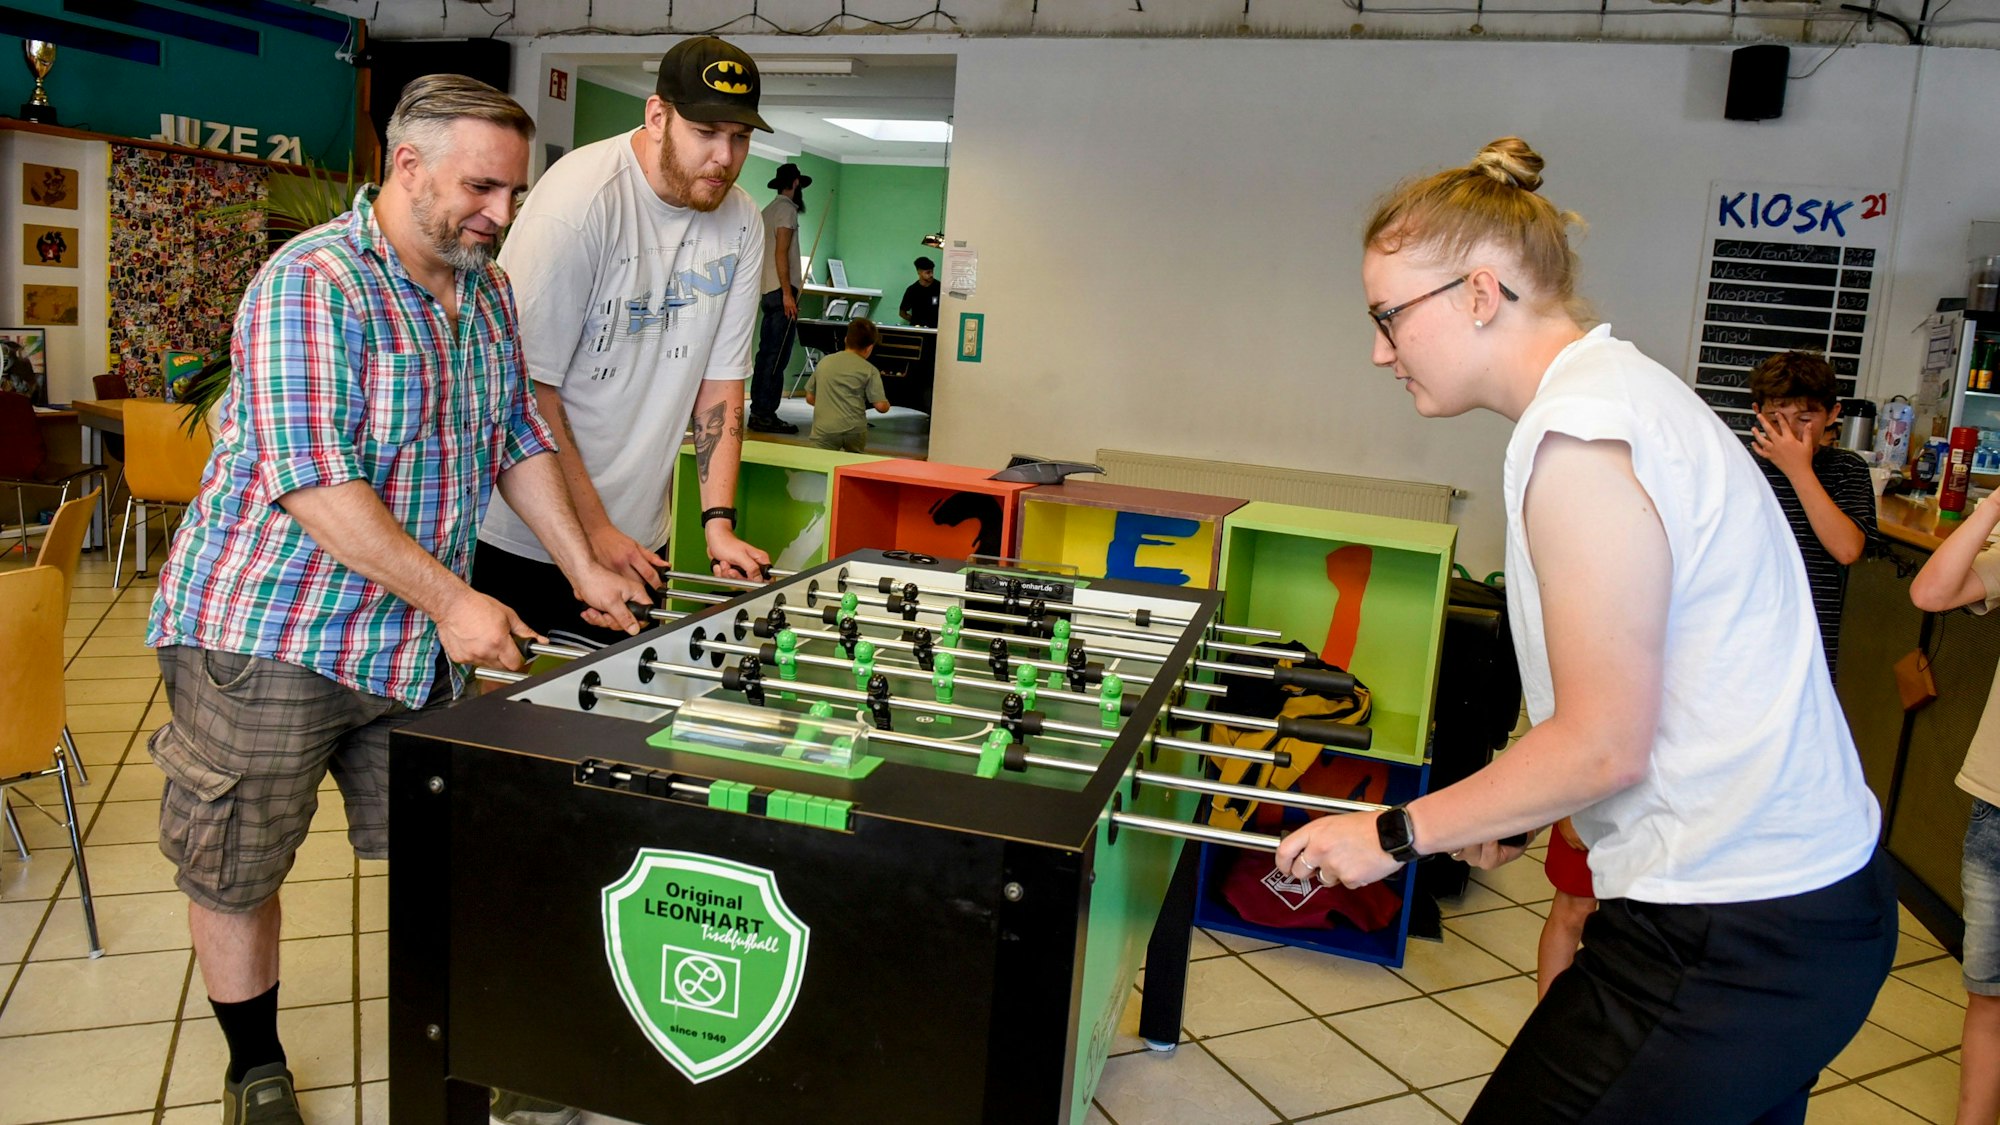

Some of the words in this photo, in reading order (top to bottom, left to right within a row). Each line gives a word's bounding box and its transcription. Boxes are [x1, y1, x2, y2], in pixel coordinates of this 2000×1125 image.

[151, 114, 258, 158] JUZE
[267, 134, 302, 166] 21
[1719, 192, 1854, 237] KIOSK
[1861, 193, 1887, 219] 21
[1713, 264, 1766, 280] Wasser
[1711, 284, 1785, 302] Knoppers
[1706, 326, 1751, 344] Pingui
[666, 882, 742, 910] Original
[644, 898, 764, 933] LEONHART
[670, 1025, 698, 1037] since
[702, 1031, 727, 1044] 1949
